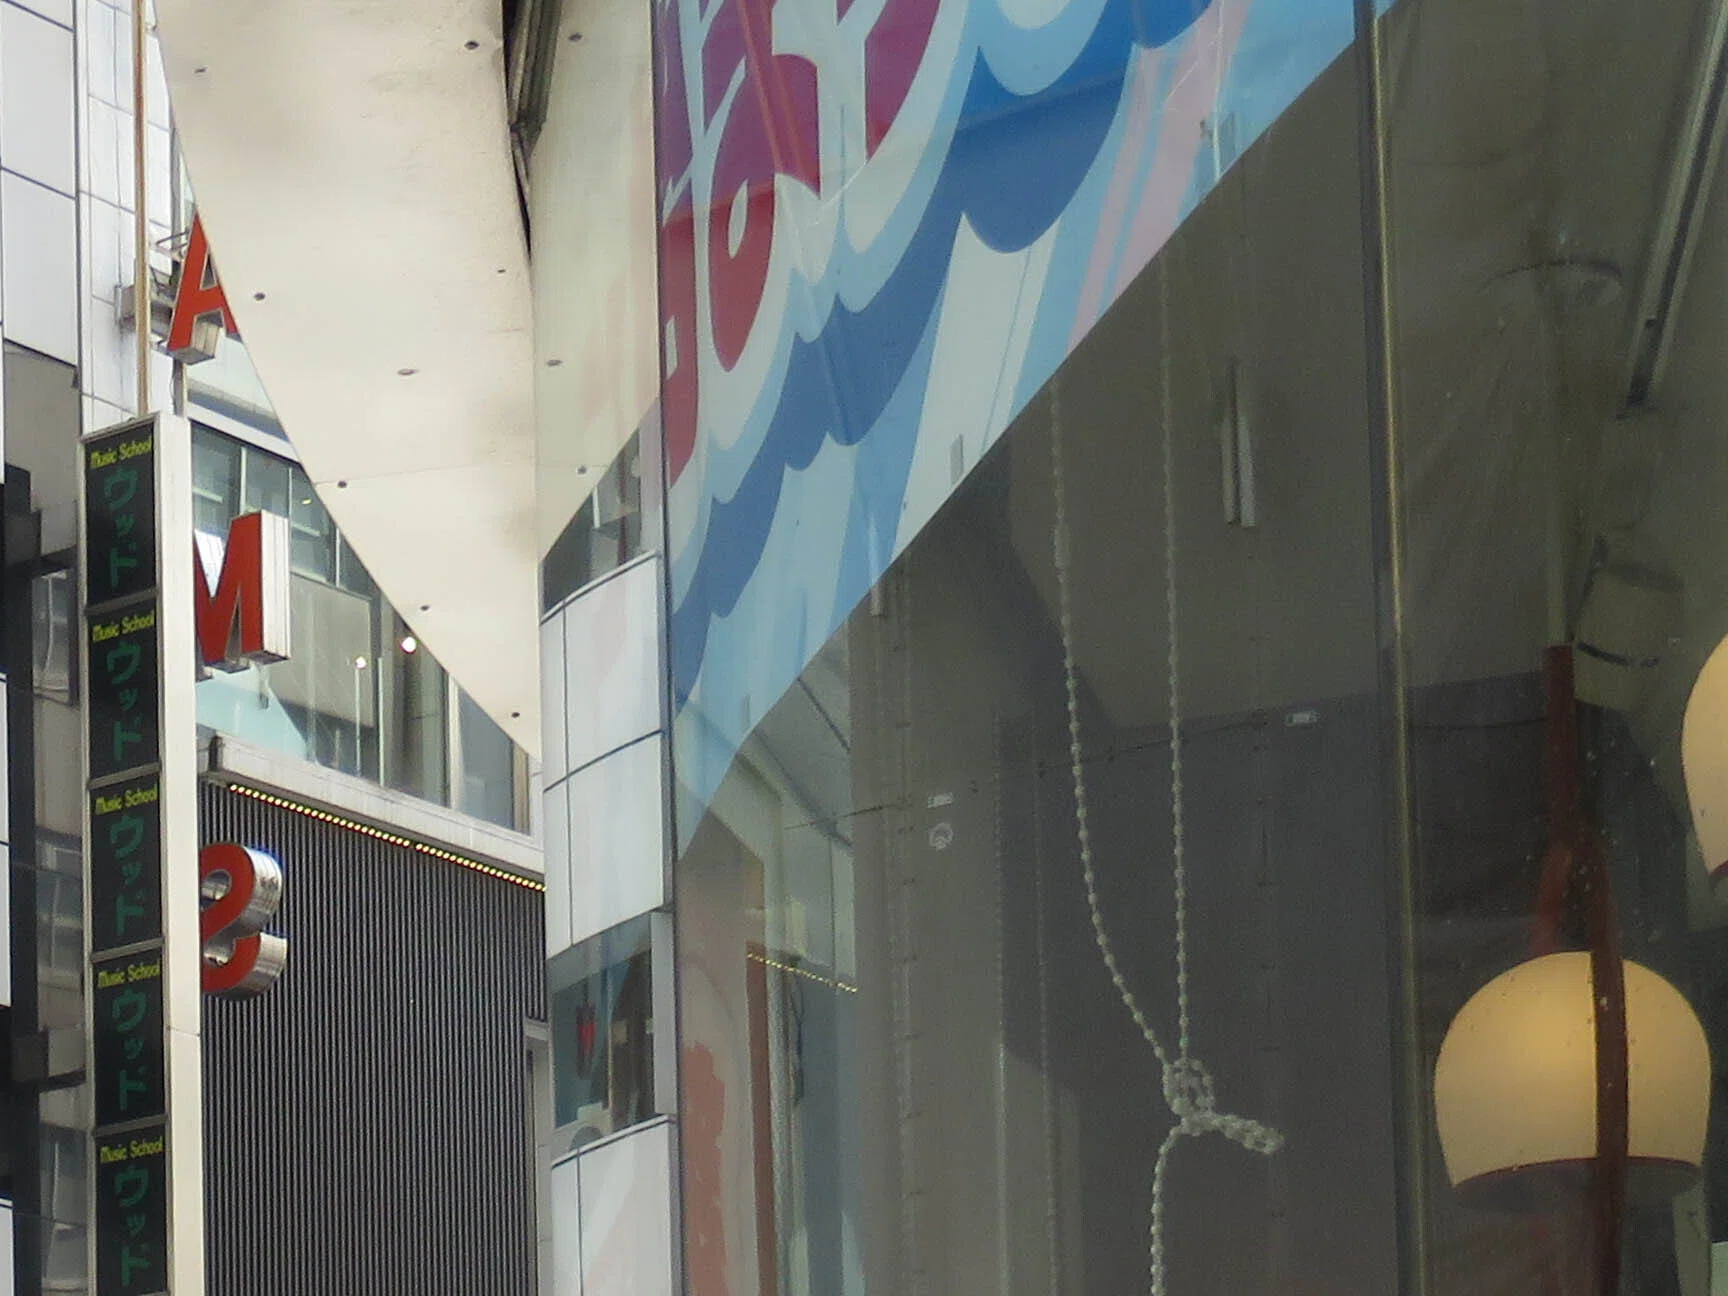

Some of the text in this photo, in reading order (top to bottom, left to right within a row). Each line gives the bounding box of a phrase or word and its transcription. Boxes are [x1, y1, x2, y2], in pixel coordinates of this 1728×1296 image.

[90, 436, 153, 469] Music School
[103, 466, 138, 587] ウッド
[93, 610, 155, 643] Music School
[106, 641, 142, 761] ウッド
[95, 784, 158, 816] Music School
[110, 814, 145, 936] ウッド
[98, 958, 161, 989] Music School
[111, 988, 148, 1111] ウッド
[100, 1135, 163, 1164] Music School
[114, 1163, 150, 1287] ウッド
